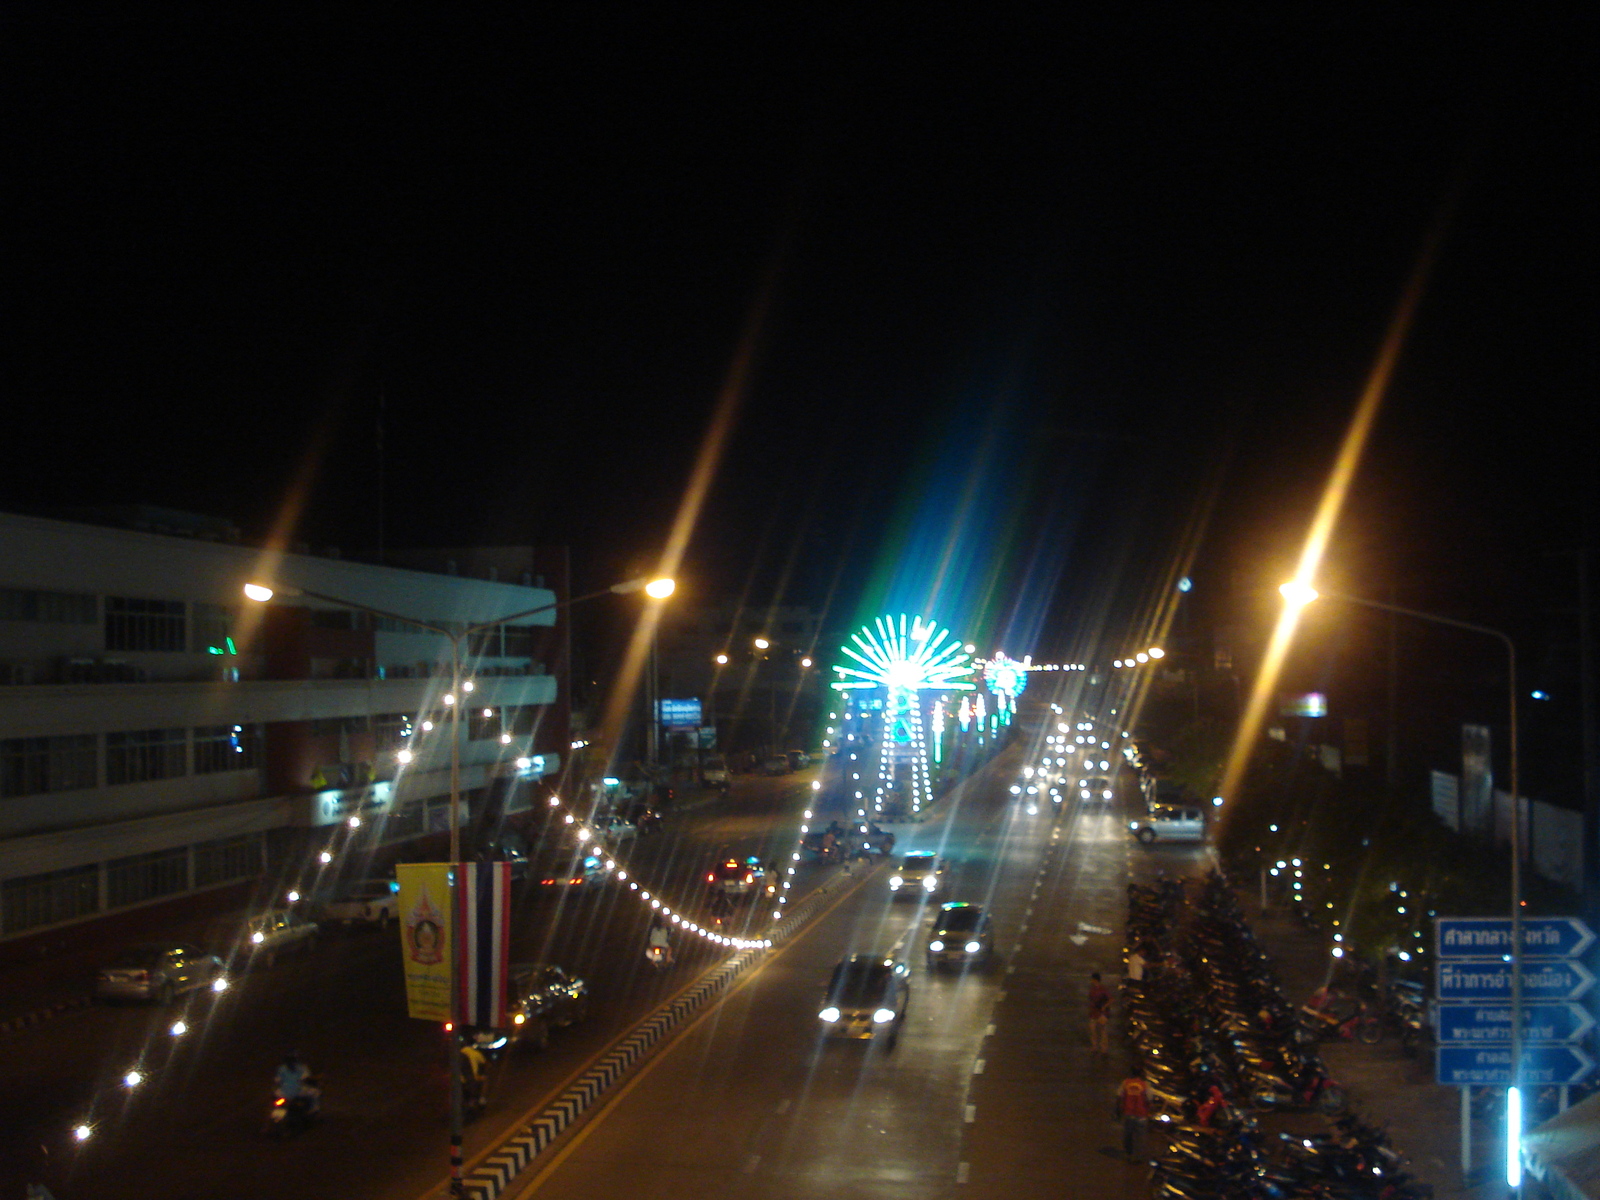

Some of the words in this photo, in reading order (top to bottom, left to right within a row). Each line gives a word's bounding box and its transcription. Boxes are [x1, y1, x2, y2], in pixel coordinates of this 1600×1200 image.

[1444, 925, 1560, 945] ศาลากลางังหวัด
